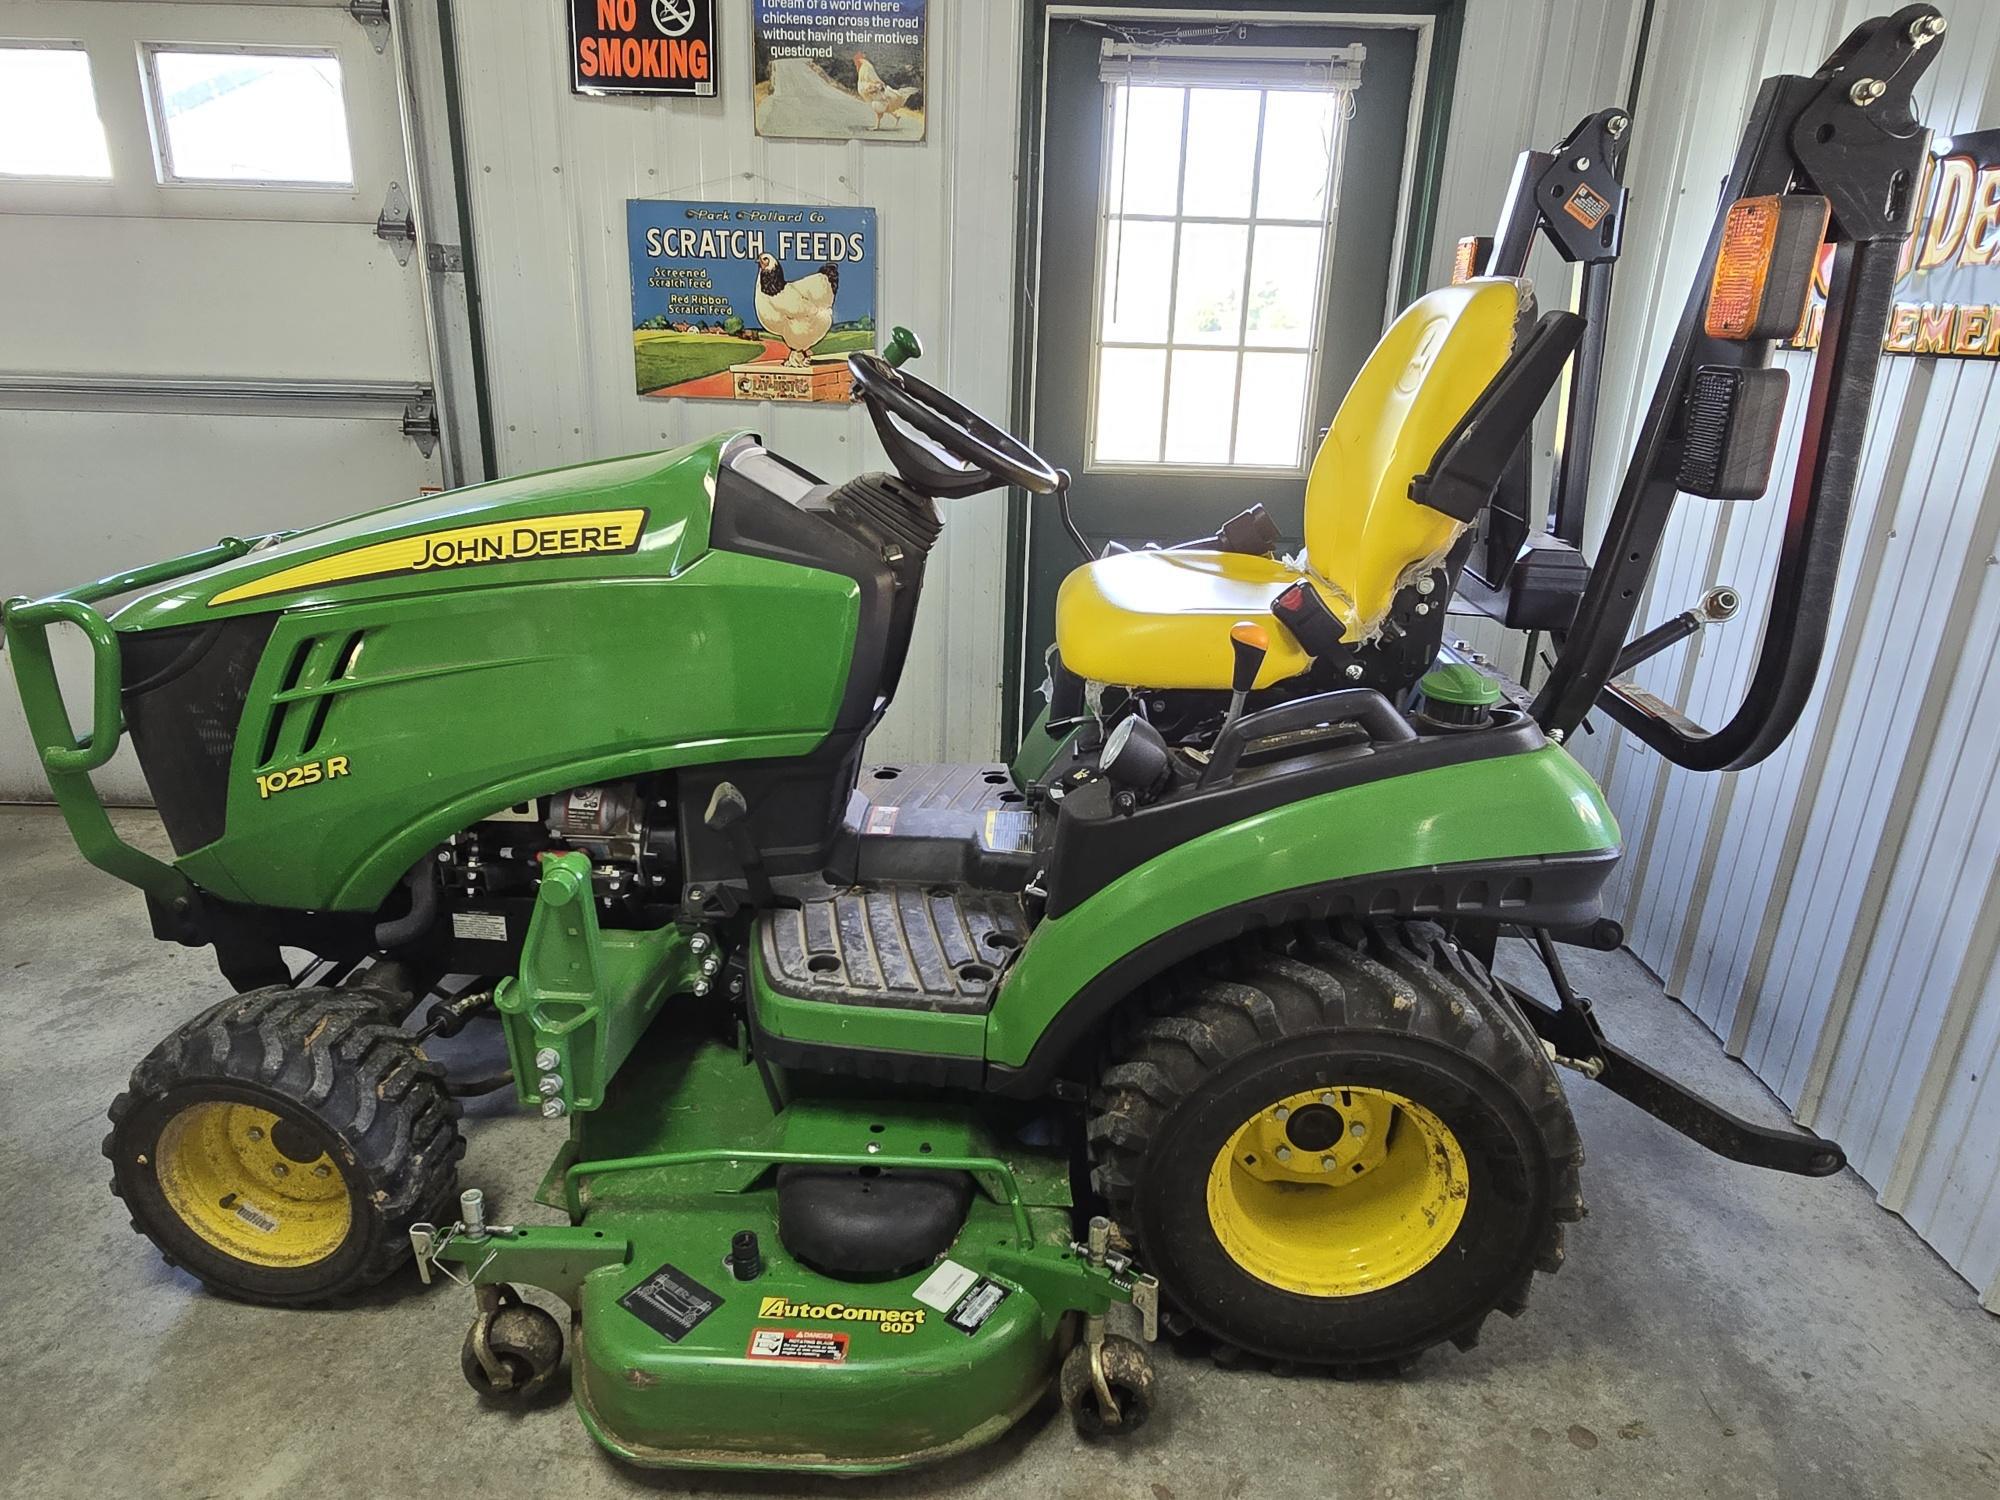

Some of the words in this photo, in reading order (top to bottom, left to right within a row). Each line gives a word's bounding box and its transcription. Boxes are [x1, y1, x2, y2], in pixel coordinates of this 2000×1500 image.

[769, 0, 805, 8] dream
[807, 0, 818, 8] of
[820, 0, 828, 9] a
[830, 0, 862, 10] world
[863, 1, 900, 12] where
[597, 0, 637, 32] NO
[763, 12, 813, 25] chickens
[815, 15, 836, 26] can
[838, 16, 869, 27] cross
[872, 15, 891, 28] the
[893, 16, 919, 29] road
[763, 28, 806, 41] without
[808, 29, 844, 44] having
[846, 30, 872, 43] their
[875, 32, 919, 44] motives
[580, 36, 708, 79] SMOKING
[770, 45, 833, 58] questioned
[690, 209, 730, 221] Park
[744, 210, 803, 223] Pollard
[809, 211, 825, 223] Co
[646, 227, 765, 259] SCRATCH
[778, 231, 865, 262] FEEDS
[654, 266, 707, 278] Screened
[648, 277, 686, 288] Scratch
[689, 279, 713, 289] Feed
[671, 294, 689, 304] Red
[691, 295, 729, 305] Ribbon
[668, 305, 707, 315] Scratch
[709, 306, 733, 316] Feed
[412, 534, 504, 568] JOHN
[512, 525, 623, 555] DEERE
[256, 761, 323, 800] 1025
[326, 755, 350, 780] R
[761, 1299, 926, 1324] AutoConnect
[880, 1322, 915, 1333] 60D
